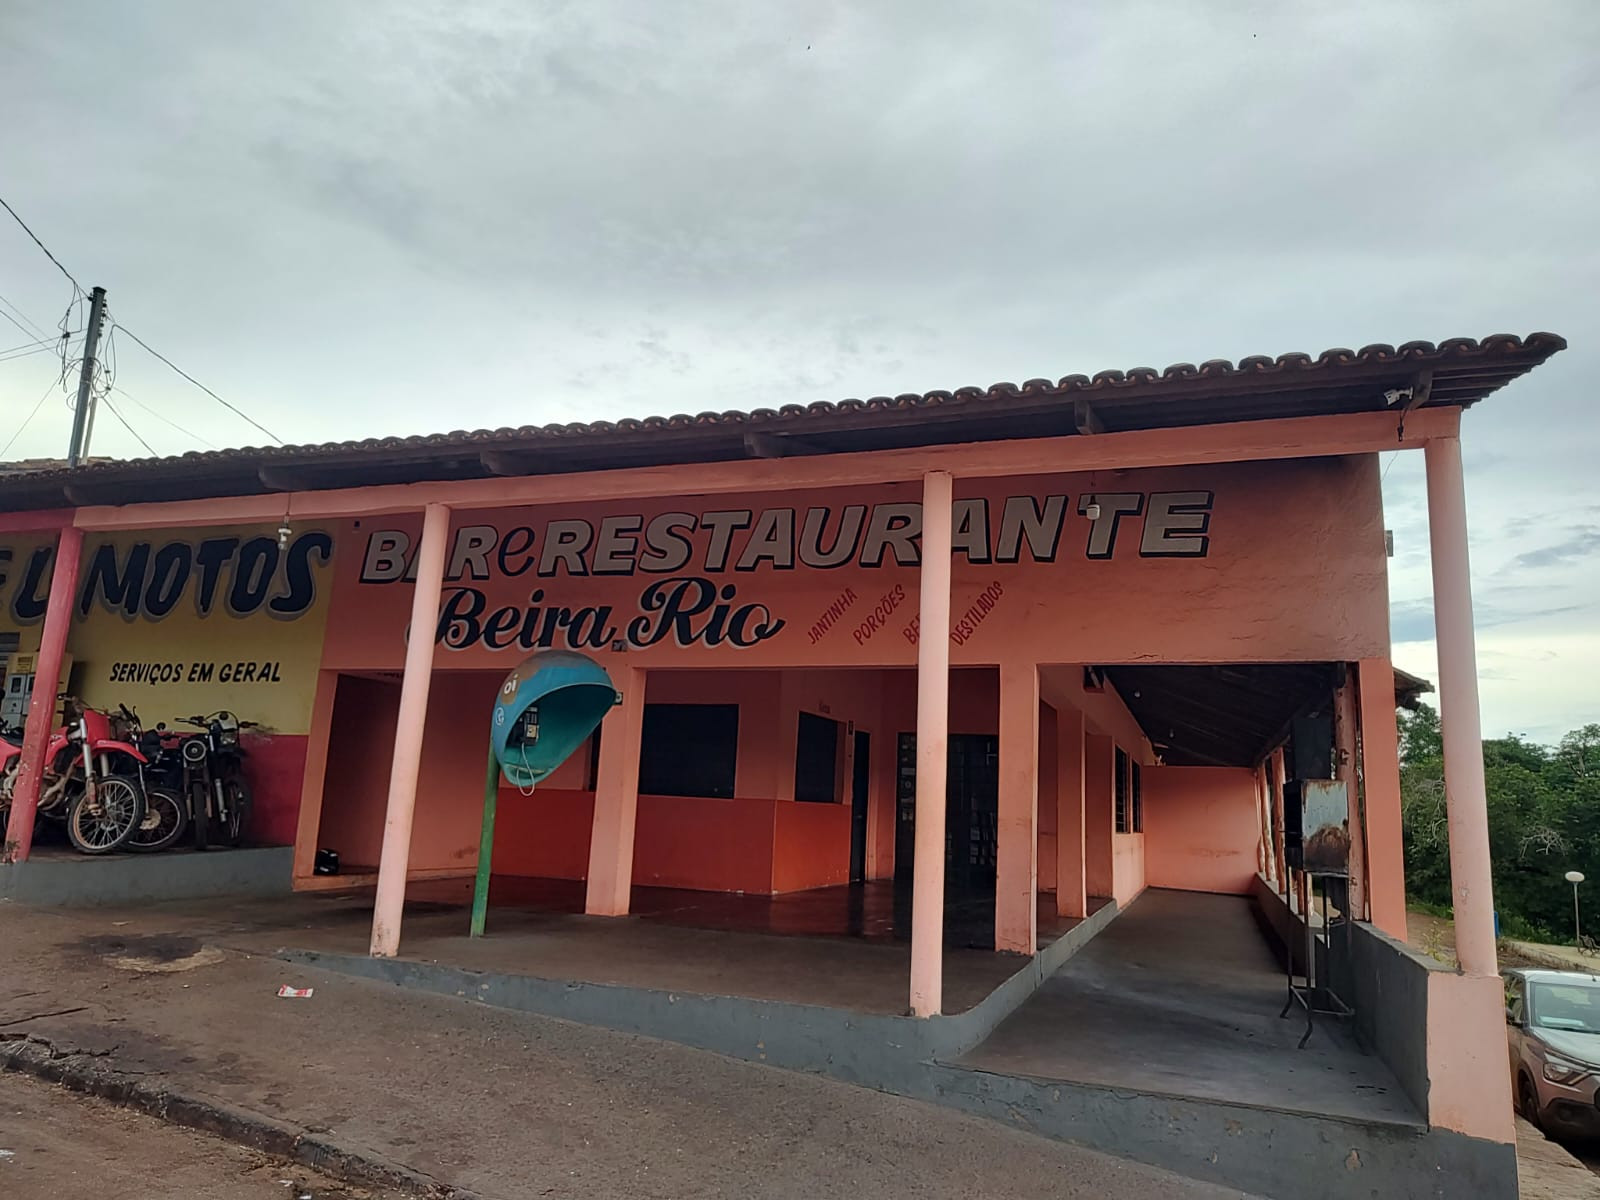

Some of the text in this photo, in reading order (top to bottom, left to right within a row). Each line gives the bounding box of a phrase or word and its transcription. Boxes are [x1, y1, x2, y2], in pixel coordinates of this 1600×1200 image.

[497, 526, 536, 577] e
[537, 489, 1214, 577] RESTAURANTE
[79, 531, 333, 618] MOTOS
[405, 576, 787, 650] Beira Rio
[807, 587, 858, 645] JANTINHA
[852, 583, 905, 645] PORÇÕES
[949, 580, 1004, 646] DESTILADOS
[109, 662, 281, 685] SERVIÇOS EM GERAL
